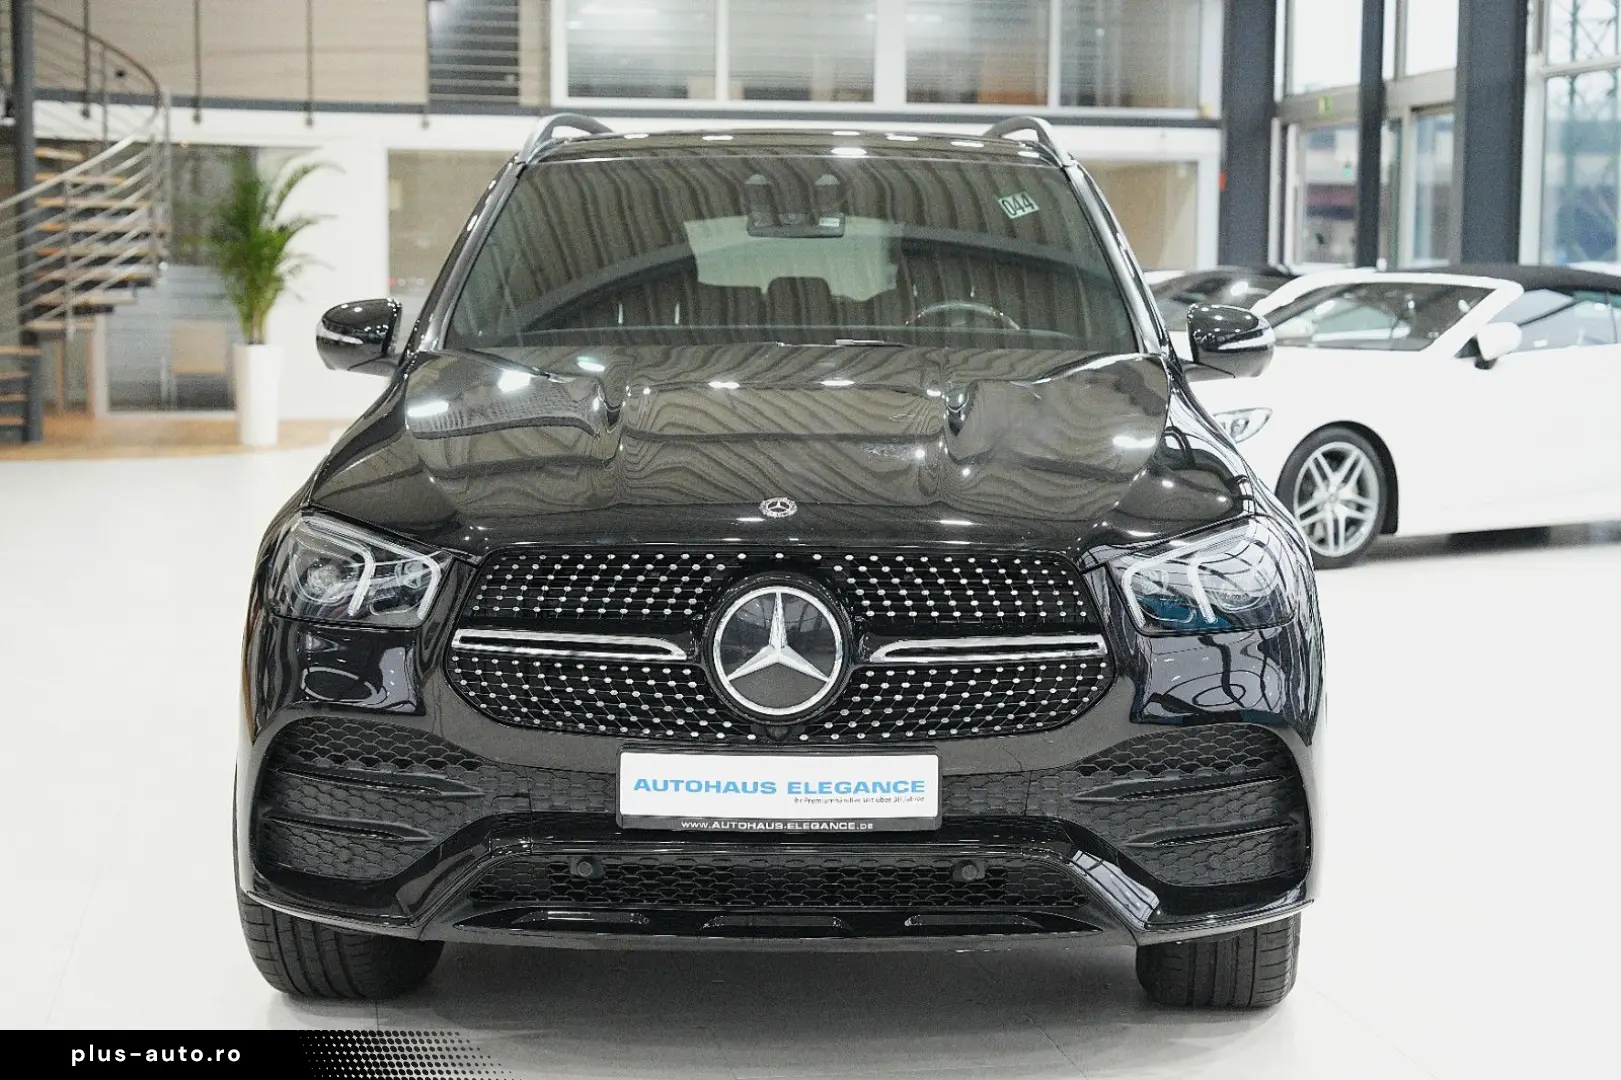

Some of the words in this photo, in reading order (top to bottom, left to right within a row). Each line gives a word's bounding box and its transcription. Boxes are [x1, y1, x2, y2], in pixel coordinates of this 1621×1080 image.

[1001, 192, 1035, 217] 044
[633, 778, 777, 795] AUTOHAUS
[787, 780, 925, 795] ELEGANCE
